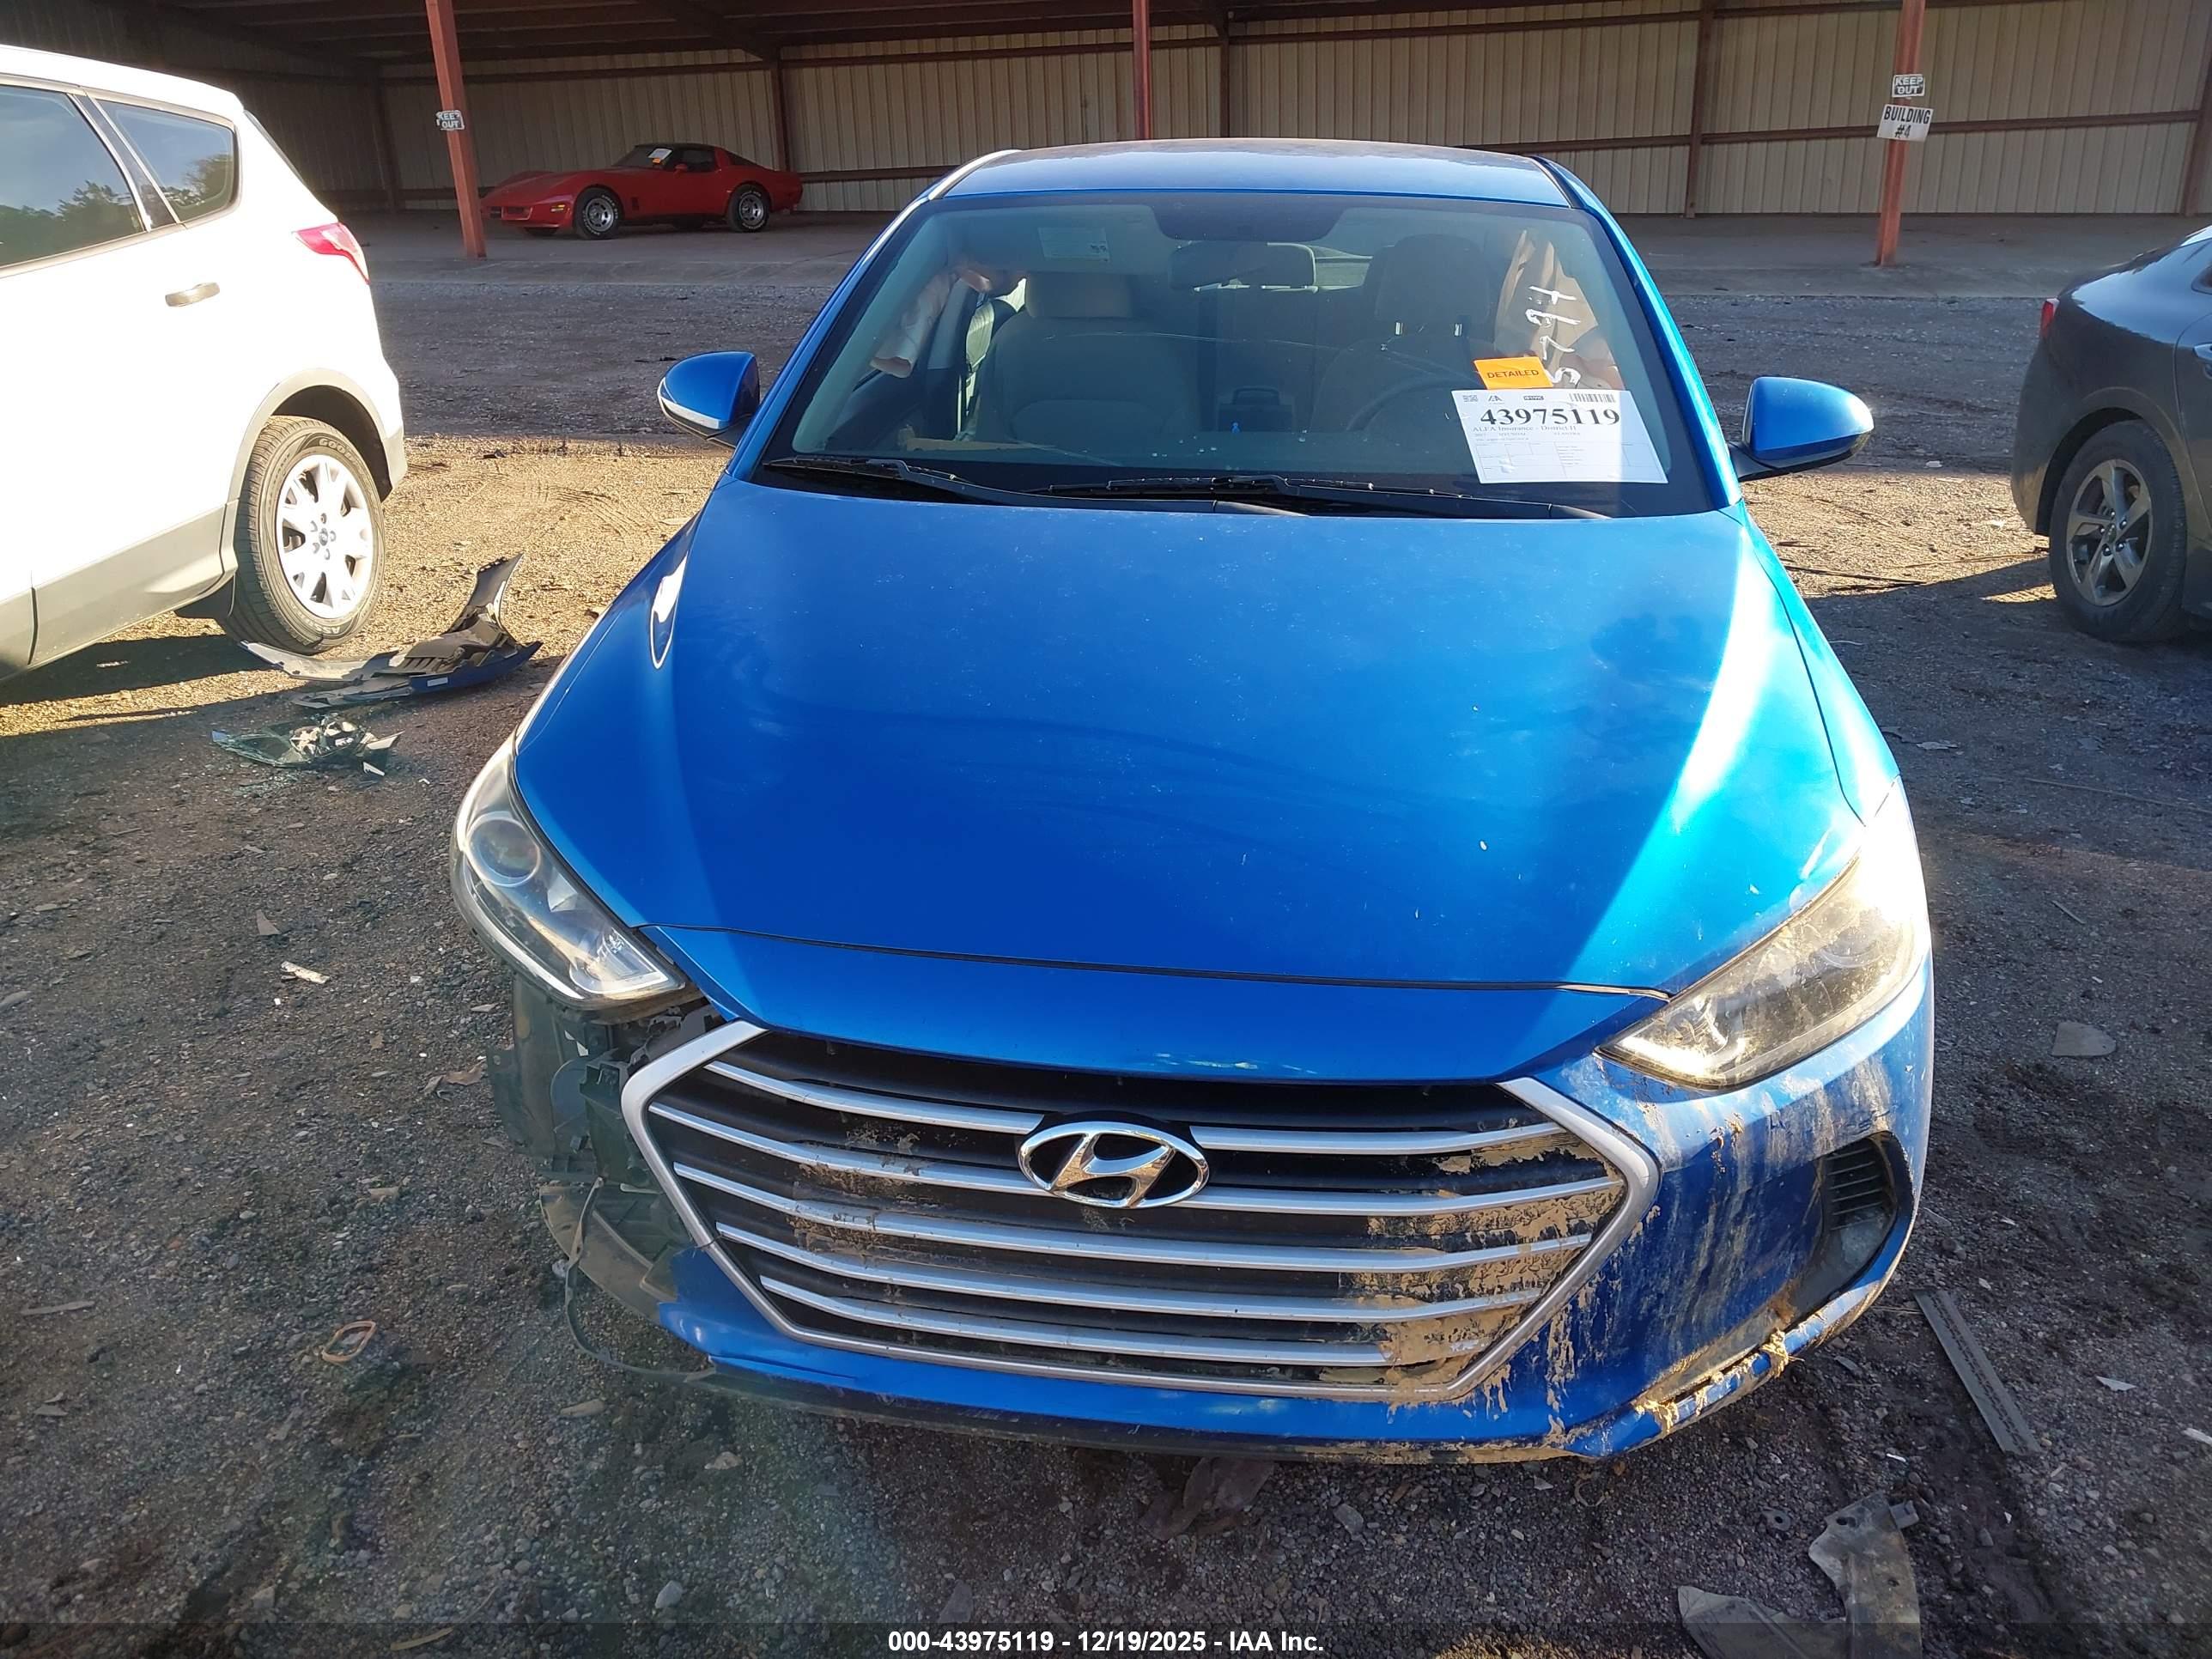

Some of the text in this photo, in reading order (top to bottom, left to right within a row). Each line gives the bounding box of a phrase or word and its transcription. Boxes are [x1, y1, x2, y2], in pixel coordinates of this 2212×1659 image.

[1895, 76, 1923, 86] KEEP
[1897, 86, 1920, 94] OUT
[1884, 106, 1931, 125] BUILDING
[441, 120, 459, 129] OUT
[1894, 124, 1911, 138] #4
[1486, 369, 1540, 379] DETAILED
[1480, 408, 1620, 425] 43975119
